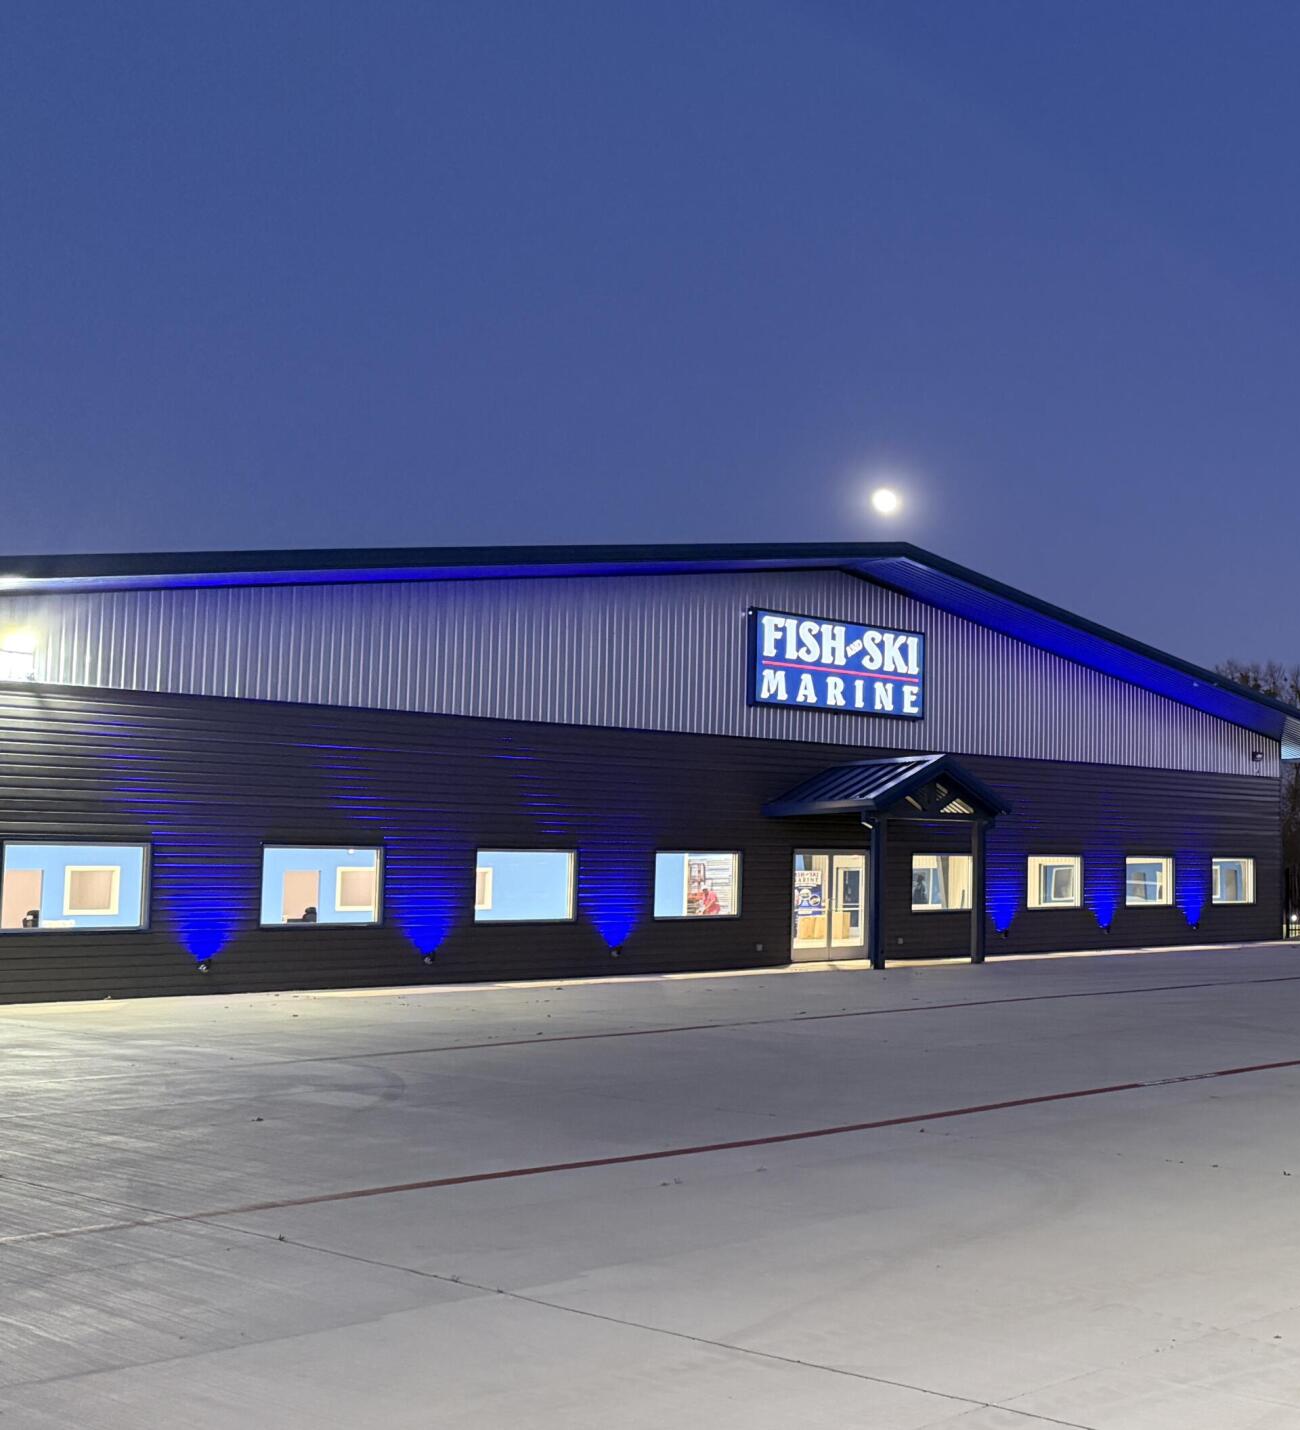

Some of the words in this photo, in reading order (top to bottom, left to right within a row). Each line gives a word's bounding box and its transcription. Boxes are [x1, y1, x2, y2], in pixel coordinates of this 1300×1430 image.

[762, 616, 847, 666] FISH
[861, 631, 919, 675] SKI
[760, 669, 919, 714] MARINE
